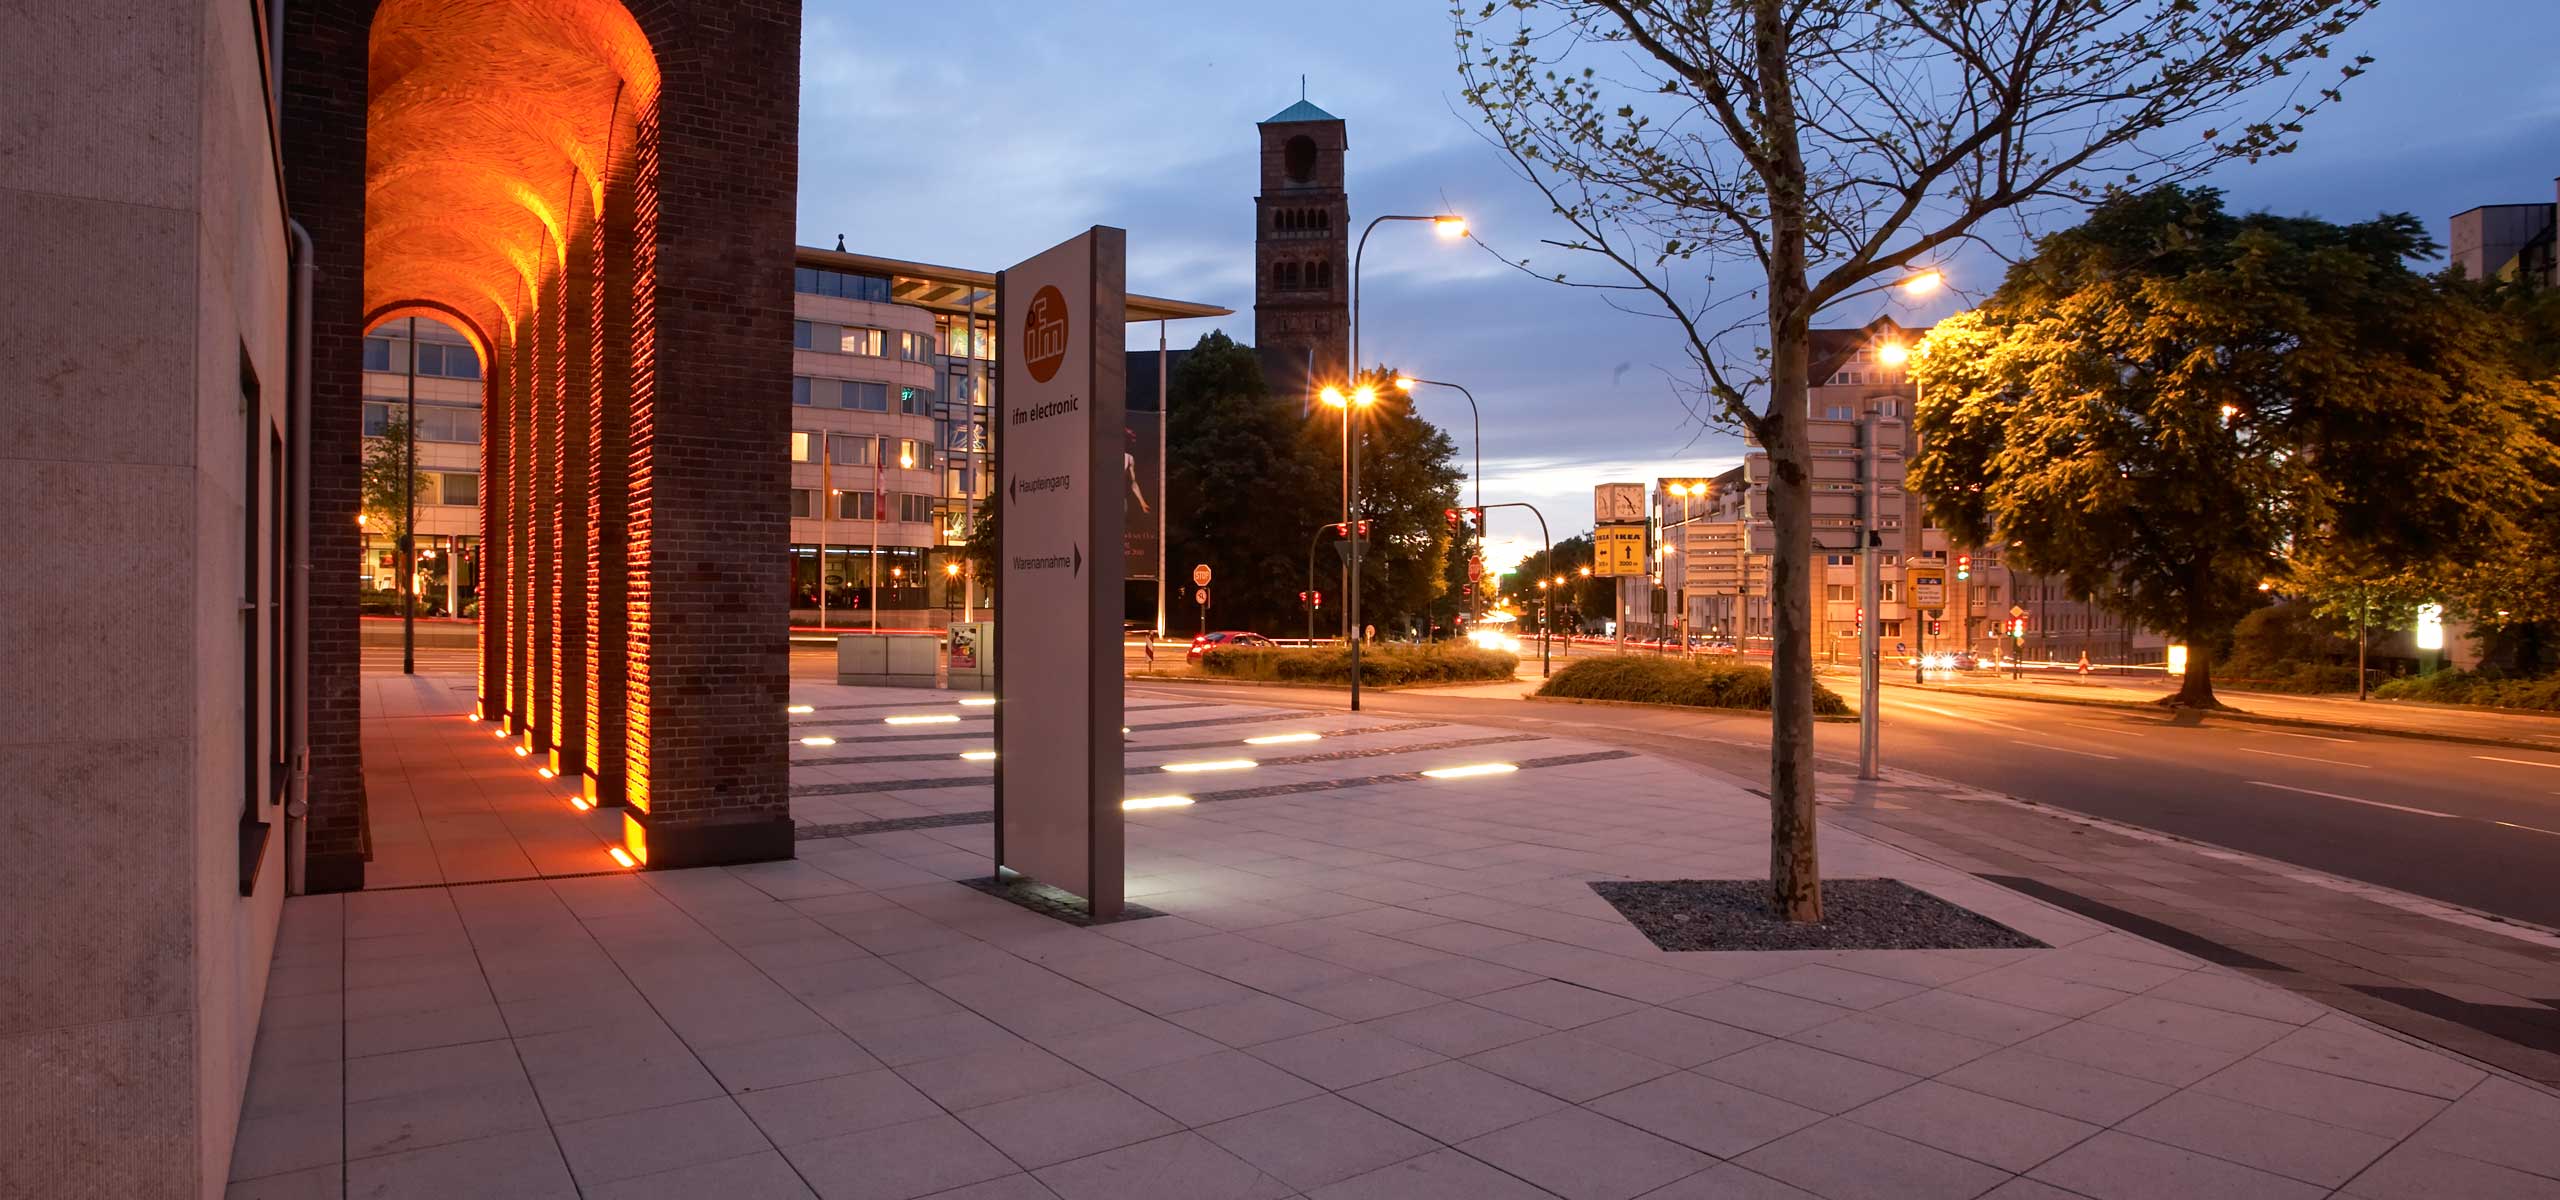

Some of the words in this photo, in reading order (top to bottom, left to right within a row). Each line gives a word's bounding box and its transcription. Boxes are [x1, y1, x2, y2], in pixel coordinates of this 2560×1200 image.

[1027, 297, 1064, 363] ifm
[1012, 407, 1028, 426] ifm
[1030, 394, 1079, 421] electronic
[1019, 474, 1070, 494] Haupteingang
[1012, 555, 1071, 570] Warenannahme
[1195, 571, 1209, 580] STOP
